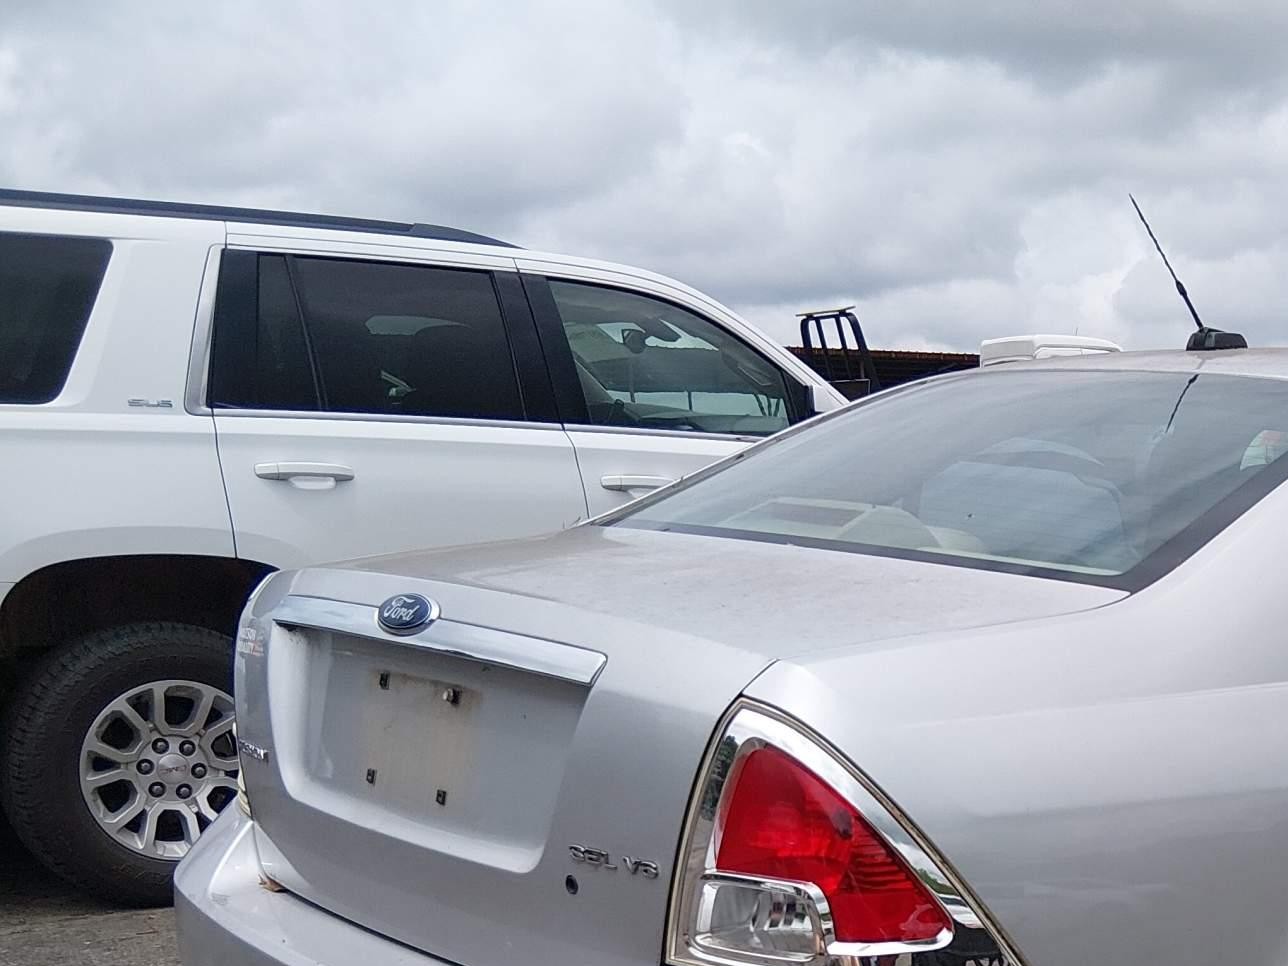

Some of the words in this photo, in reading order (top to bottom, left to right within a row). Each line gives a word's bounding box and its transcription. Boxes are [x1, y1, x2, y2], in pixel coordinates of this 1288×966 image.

[383, 596, 420, 621] Ford
[568, 844, 617, 870] SEL
[622, 856, 659, 879] V6
